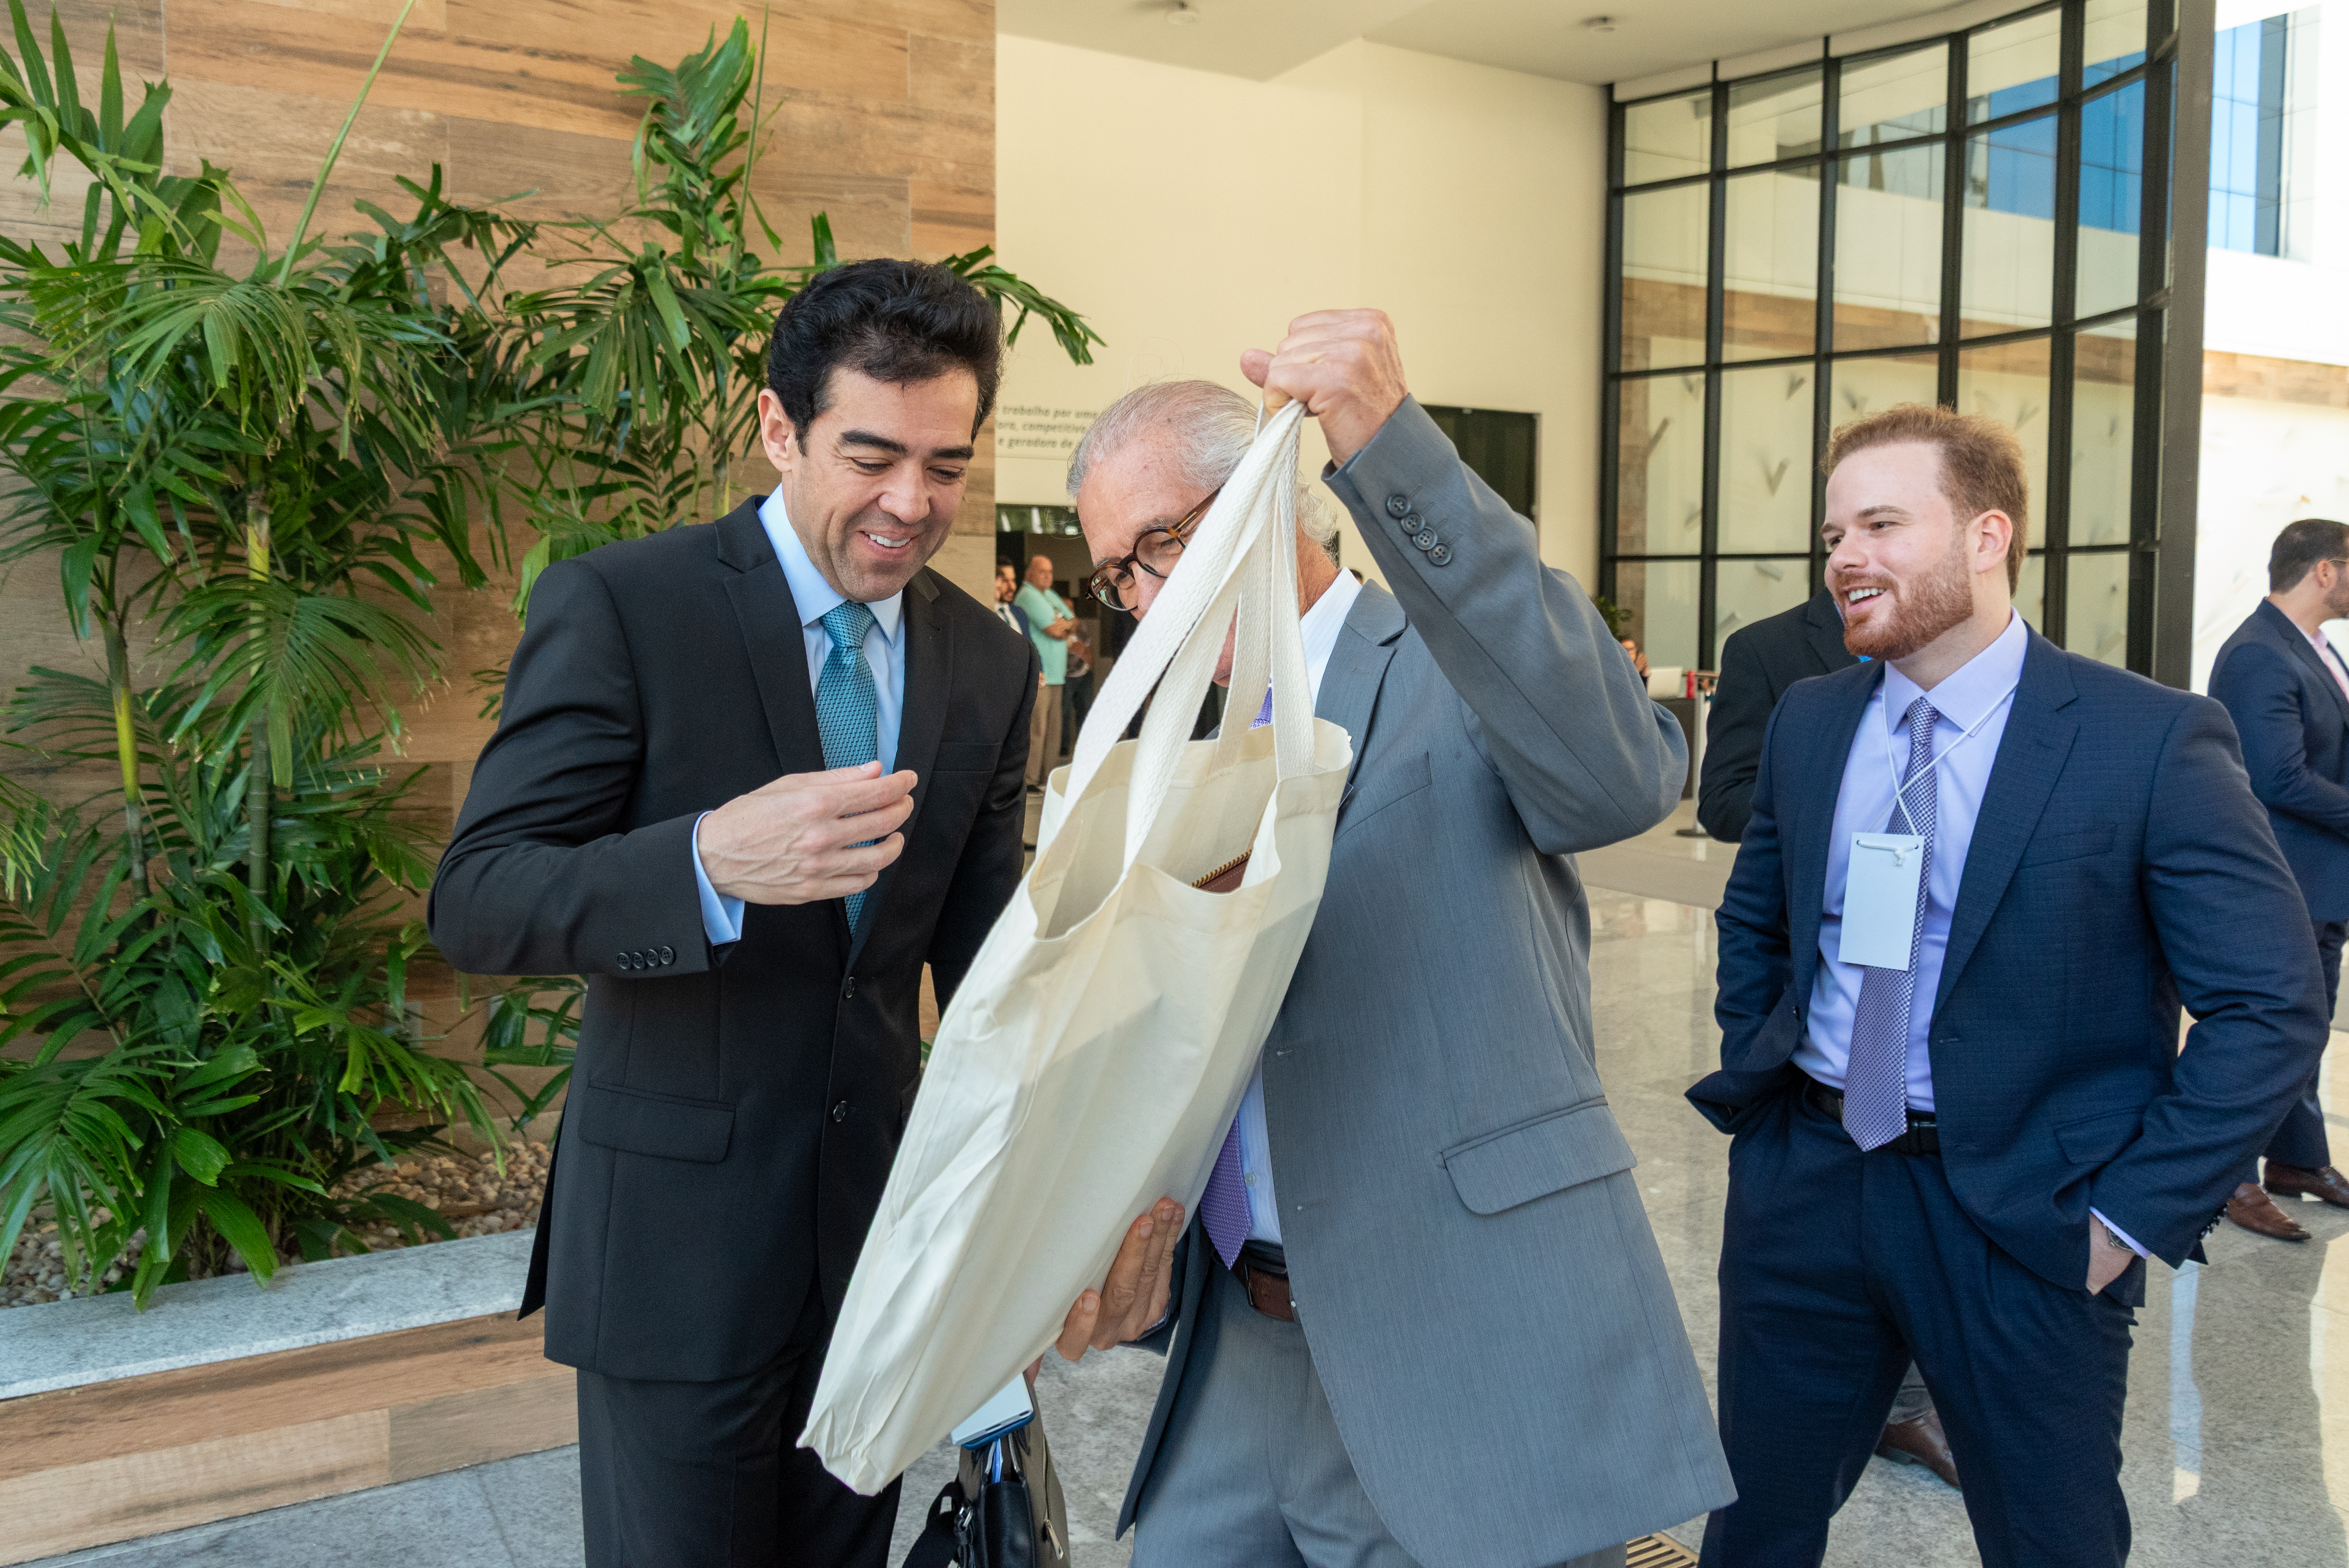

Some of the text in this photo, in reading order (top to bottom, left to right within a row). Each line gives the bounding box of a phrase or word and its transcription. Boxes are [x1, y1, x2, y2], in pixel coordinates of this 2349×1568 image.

[1002, 405, 1050, 417] trabalha
[1053, 409, 1071, 420] por
[1007, 437, 1057, 449] geradora
[1060, 438, 1073, 449] de
